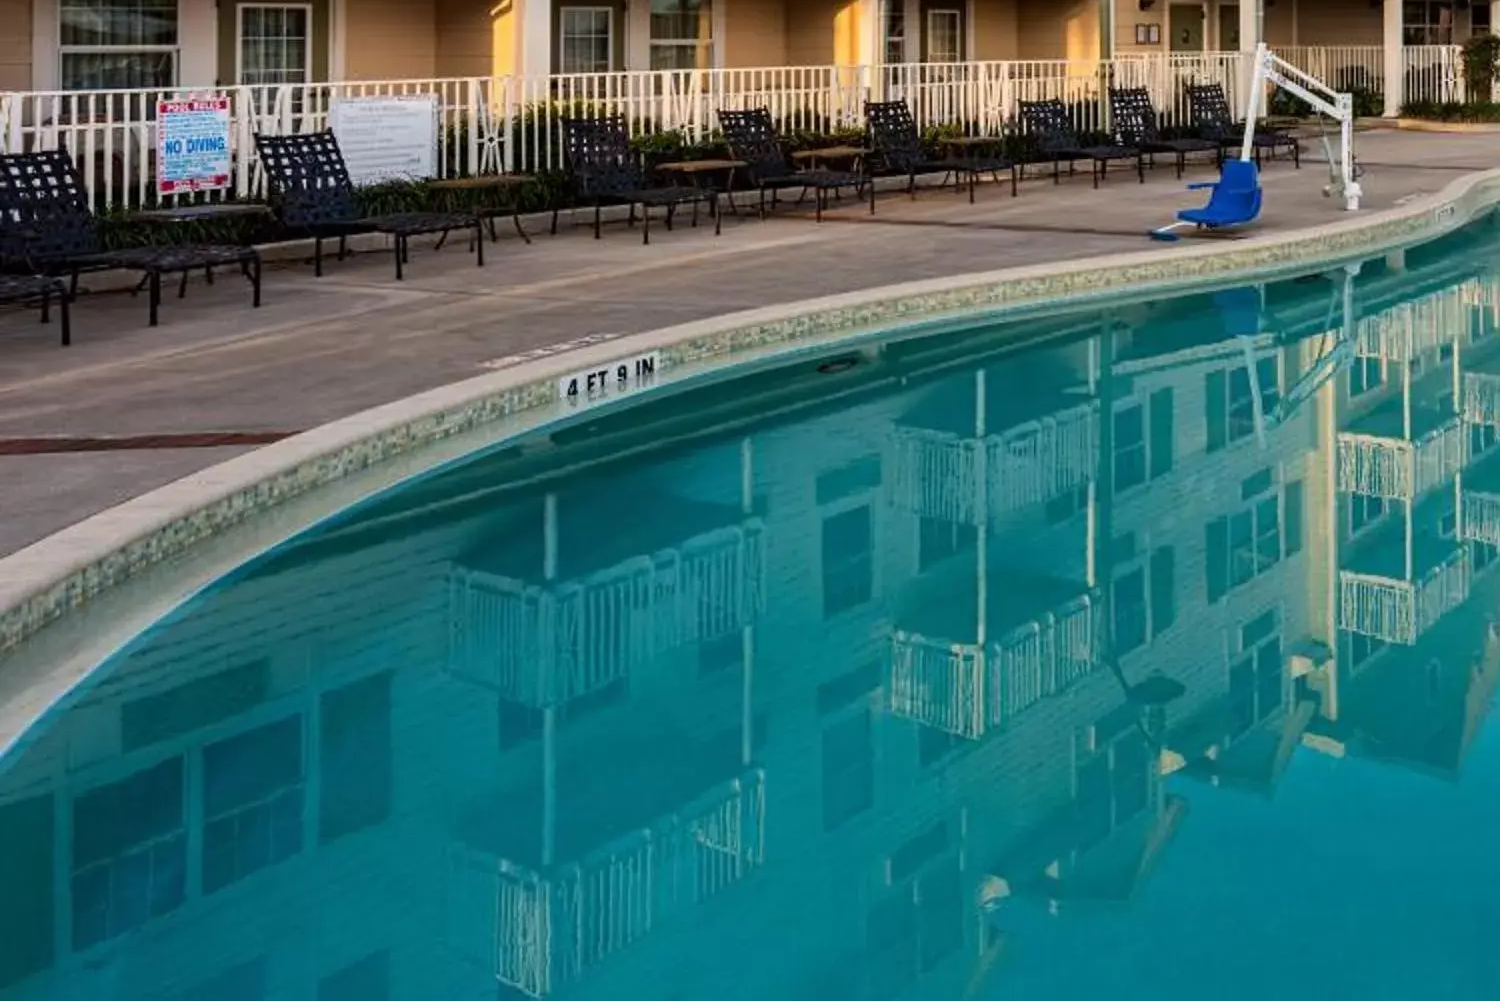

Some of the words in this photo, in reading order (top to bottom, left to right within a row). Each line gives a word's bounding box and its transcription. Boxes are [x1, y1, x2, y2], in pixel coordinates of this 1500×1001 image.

[166, 140, 181, 154] NO
[186, 137, 225, 153] DIVING
[568, 378, 578, 396] 4
[587, 370, 608, 392] FT
[618, 365, 628, 382] 9
[635, 357, 655, 376] IN
